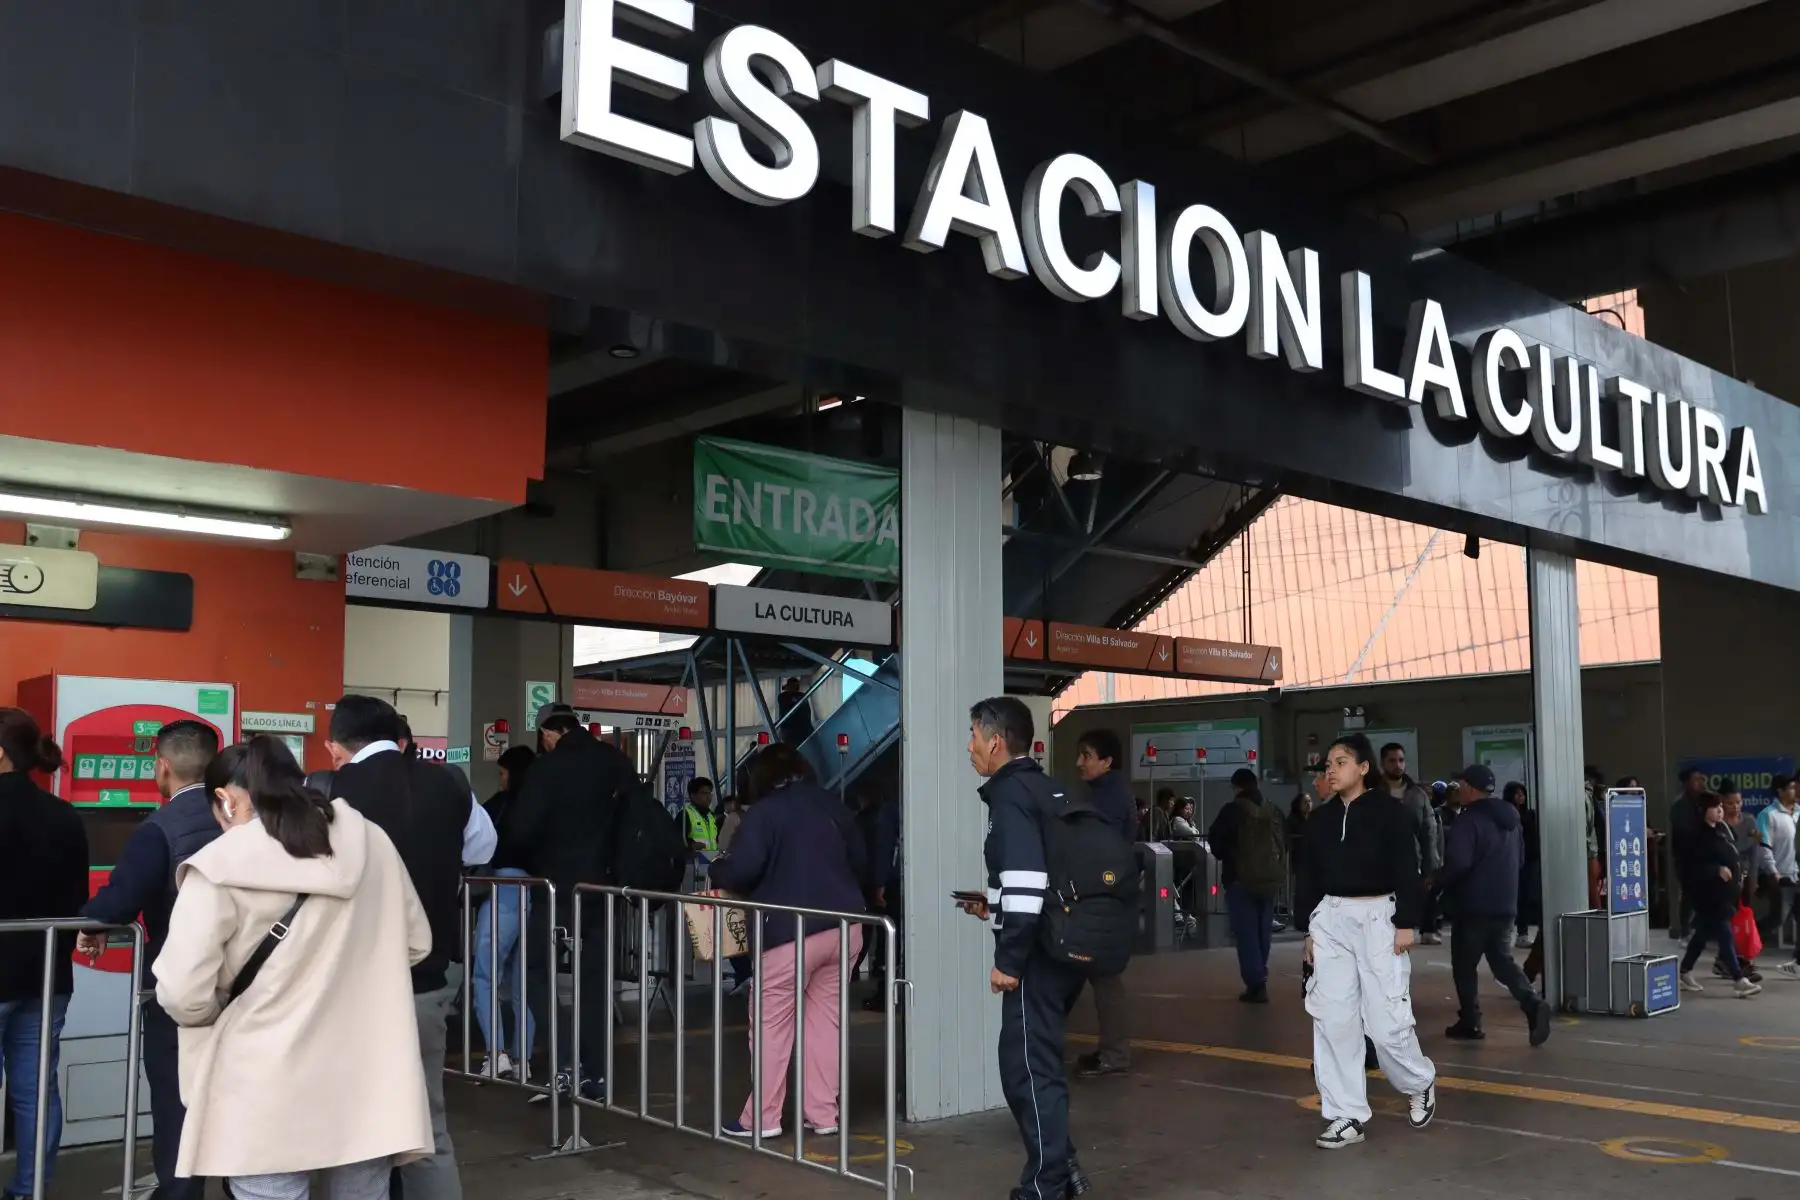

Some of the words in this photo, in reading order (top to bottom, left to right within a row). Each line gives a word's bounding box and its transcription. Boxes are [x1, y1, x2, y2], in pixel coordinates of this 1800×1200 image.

[560, 0, 1324, 373] ESTACION
[1340, 270, 1467, 421] LA
[1471, 328, 1768, 515] CULTURA
[706, 474, 899, 547] ENTRADA
[346, 573, 410, 589] eferencial
[658, 590, 698, 604] Bayóvar
[755, 602, 777, 620] LA
[780, 605, 854, 628] CULTURA
[1086, 634, 1101, 644] Villa
[1102, 636, 1109, 645] El
[1110, 638, 1139, 649] Salvador
